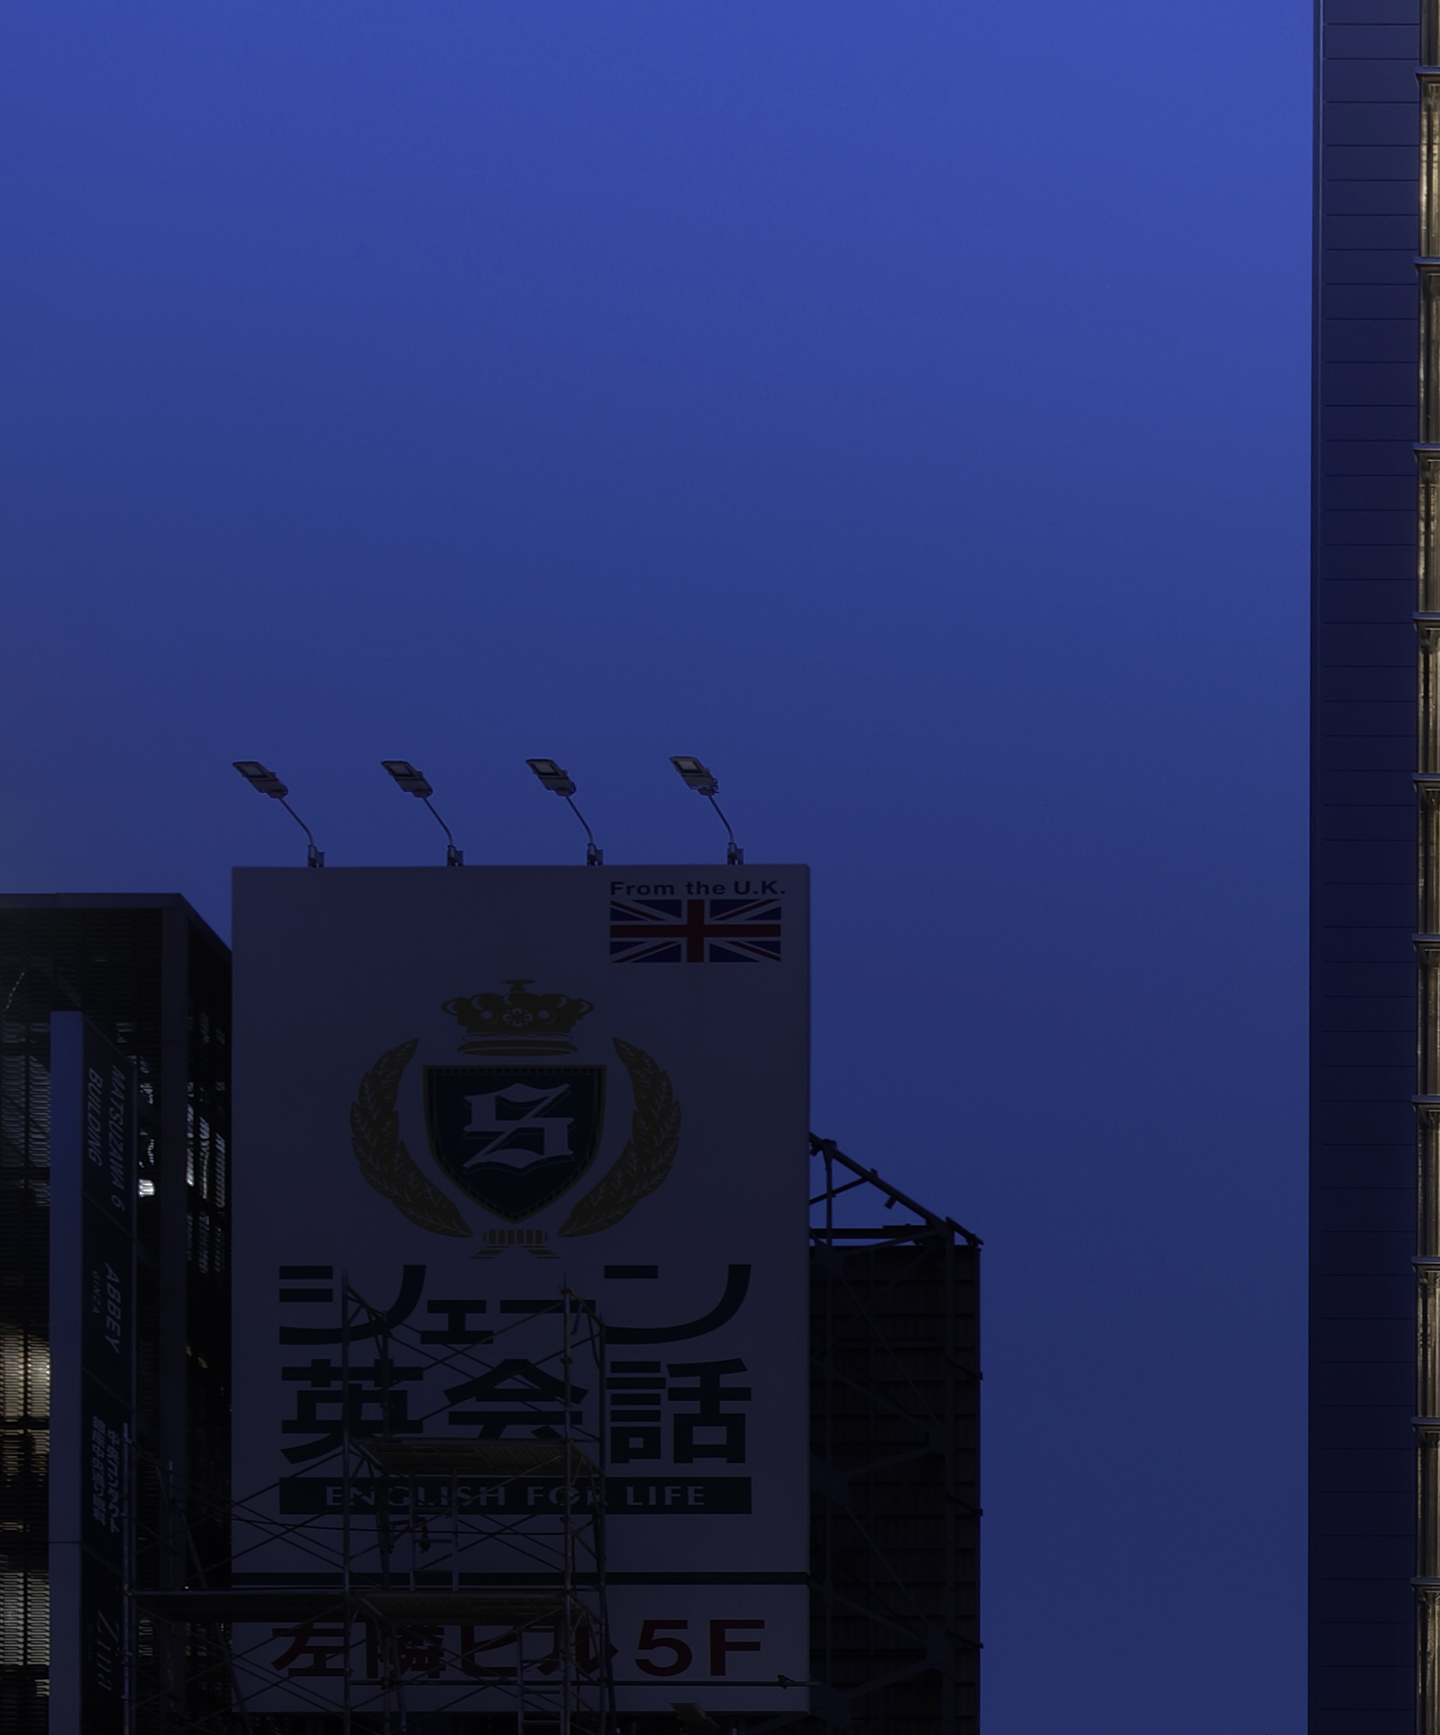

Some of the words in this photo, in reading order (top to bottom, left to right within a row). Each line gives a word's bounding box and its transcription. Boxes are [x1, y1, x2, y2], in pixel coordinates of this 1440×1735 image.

[610, 881, 675, 896] From
[685, 881, 726, 895] the
[734, 880, 786, 895] U.K.
[88, 1067, 103, 1167] BUILDING
[108, 1065, 126, 1190] MATSUZAWA
[104, 1261, 121, 1354] ABBEY
[279, 1264, 752, 1345] シェーン
[281, 1358, 752, 1464] 英会話
[325, 1485, 506, 1507] ENGLISH
[626, 1485, 706, 1506] LIFE
